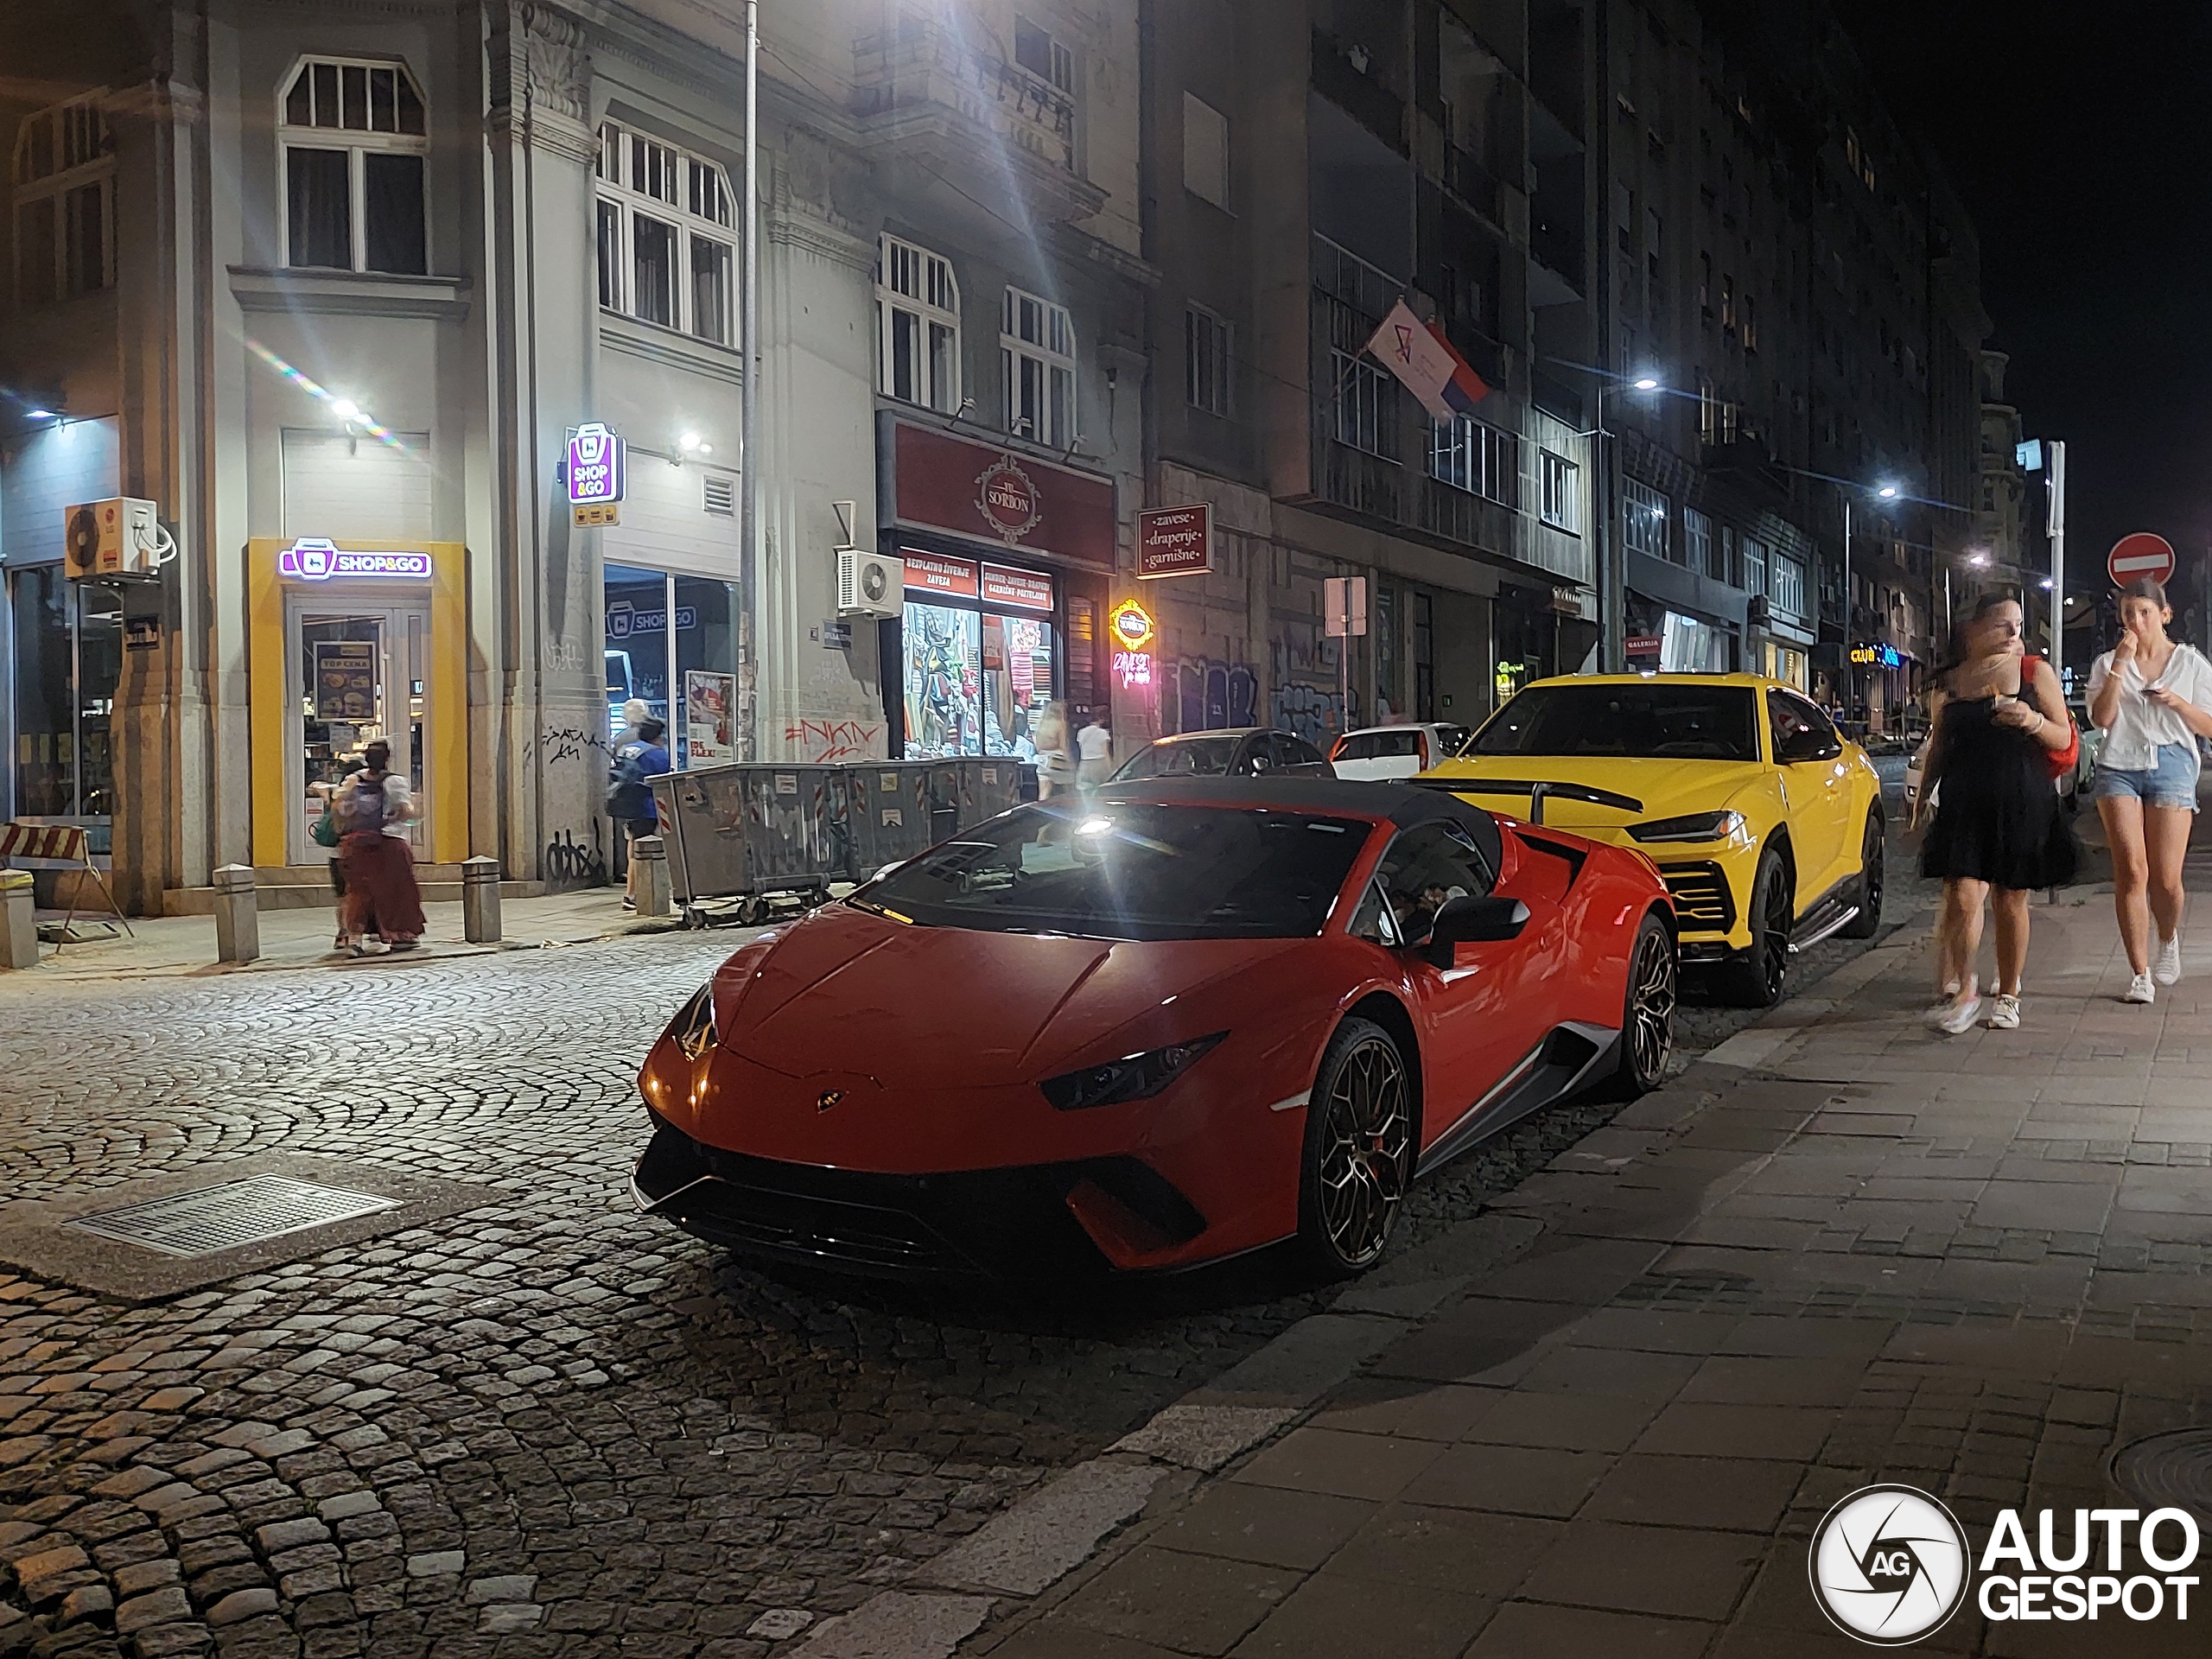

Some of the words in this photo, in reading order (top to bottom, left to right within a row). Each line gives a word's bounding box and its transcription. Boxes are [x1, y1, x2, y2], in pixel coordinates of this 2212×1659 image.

[574, 465, 608, 482] SHOP
[577, 480, 605, 496] &GO
[988, 490, 1029, 512] SORBON
[1156, 513, 1190, 525] zavese
[1149, 528, 1198, 549] draperije
[338, 554, 423, 572] SHOP&GO
[1148, 548, 1196, 569] garnišne
[1628, 639, 1659, 648] GALERIJA
